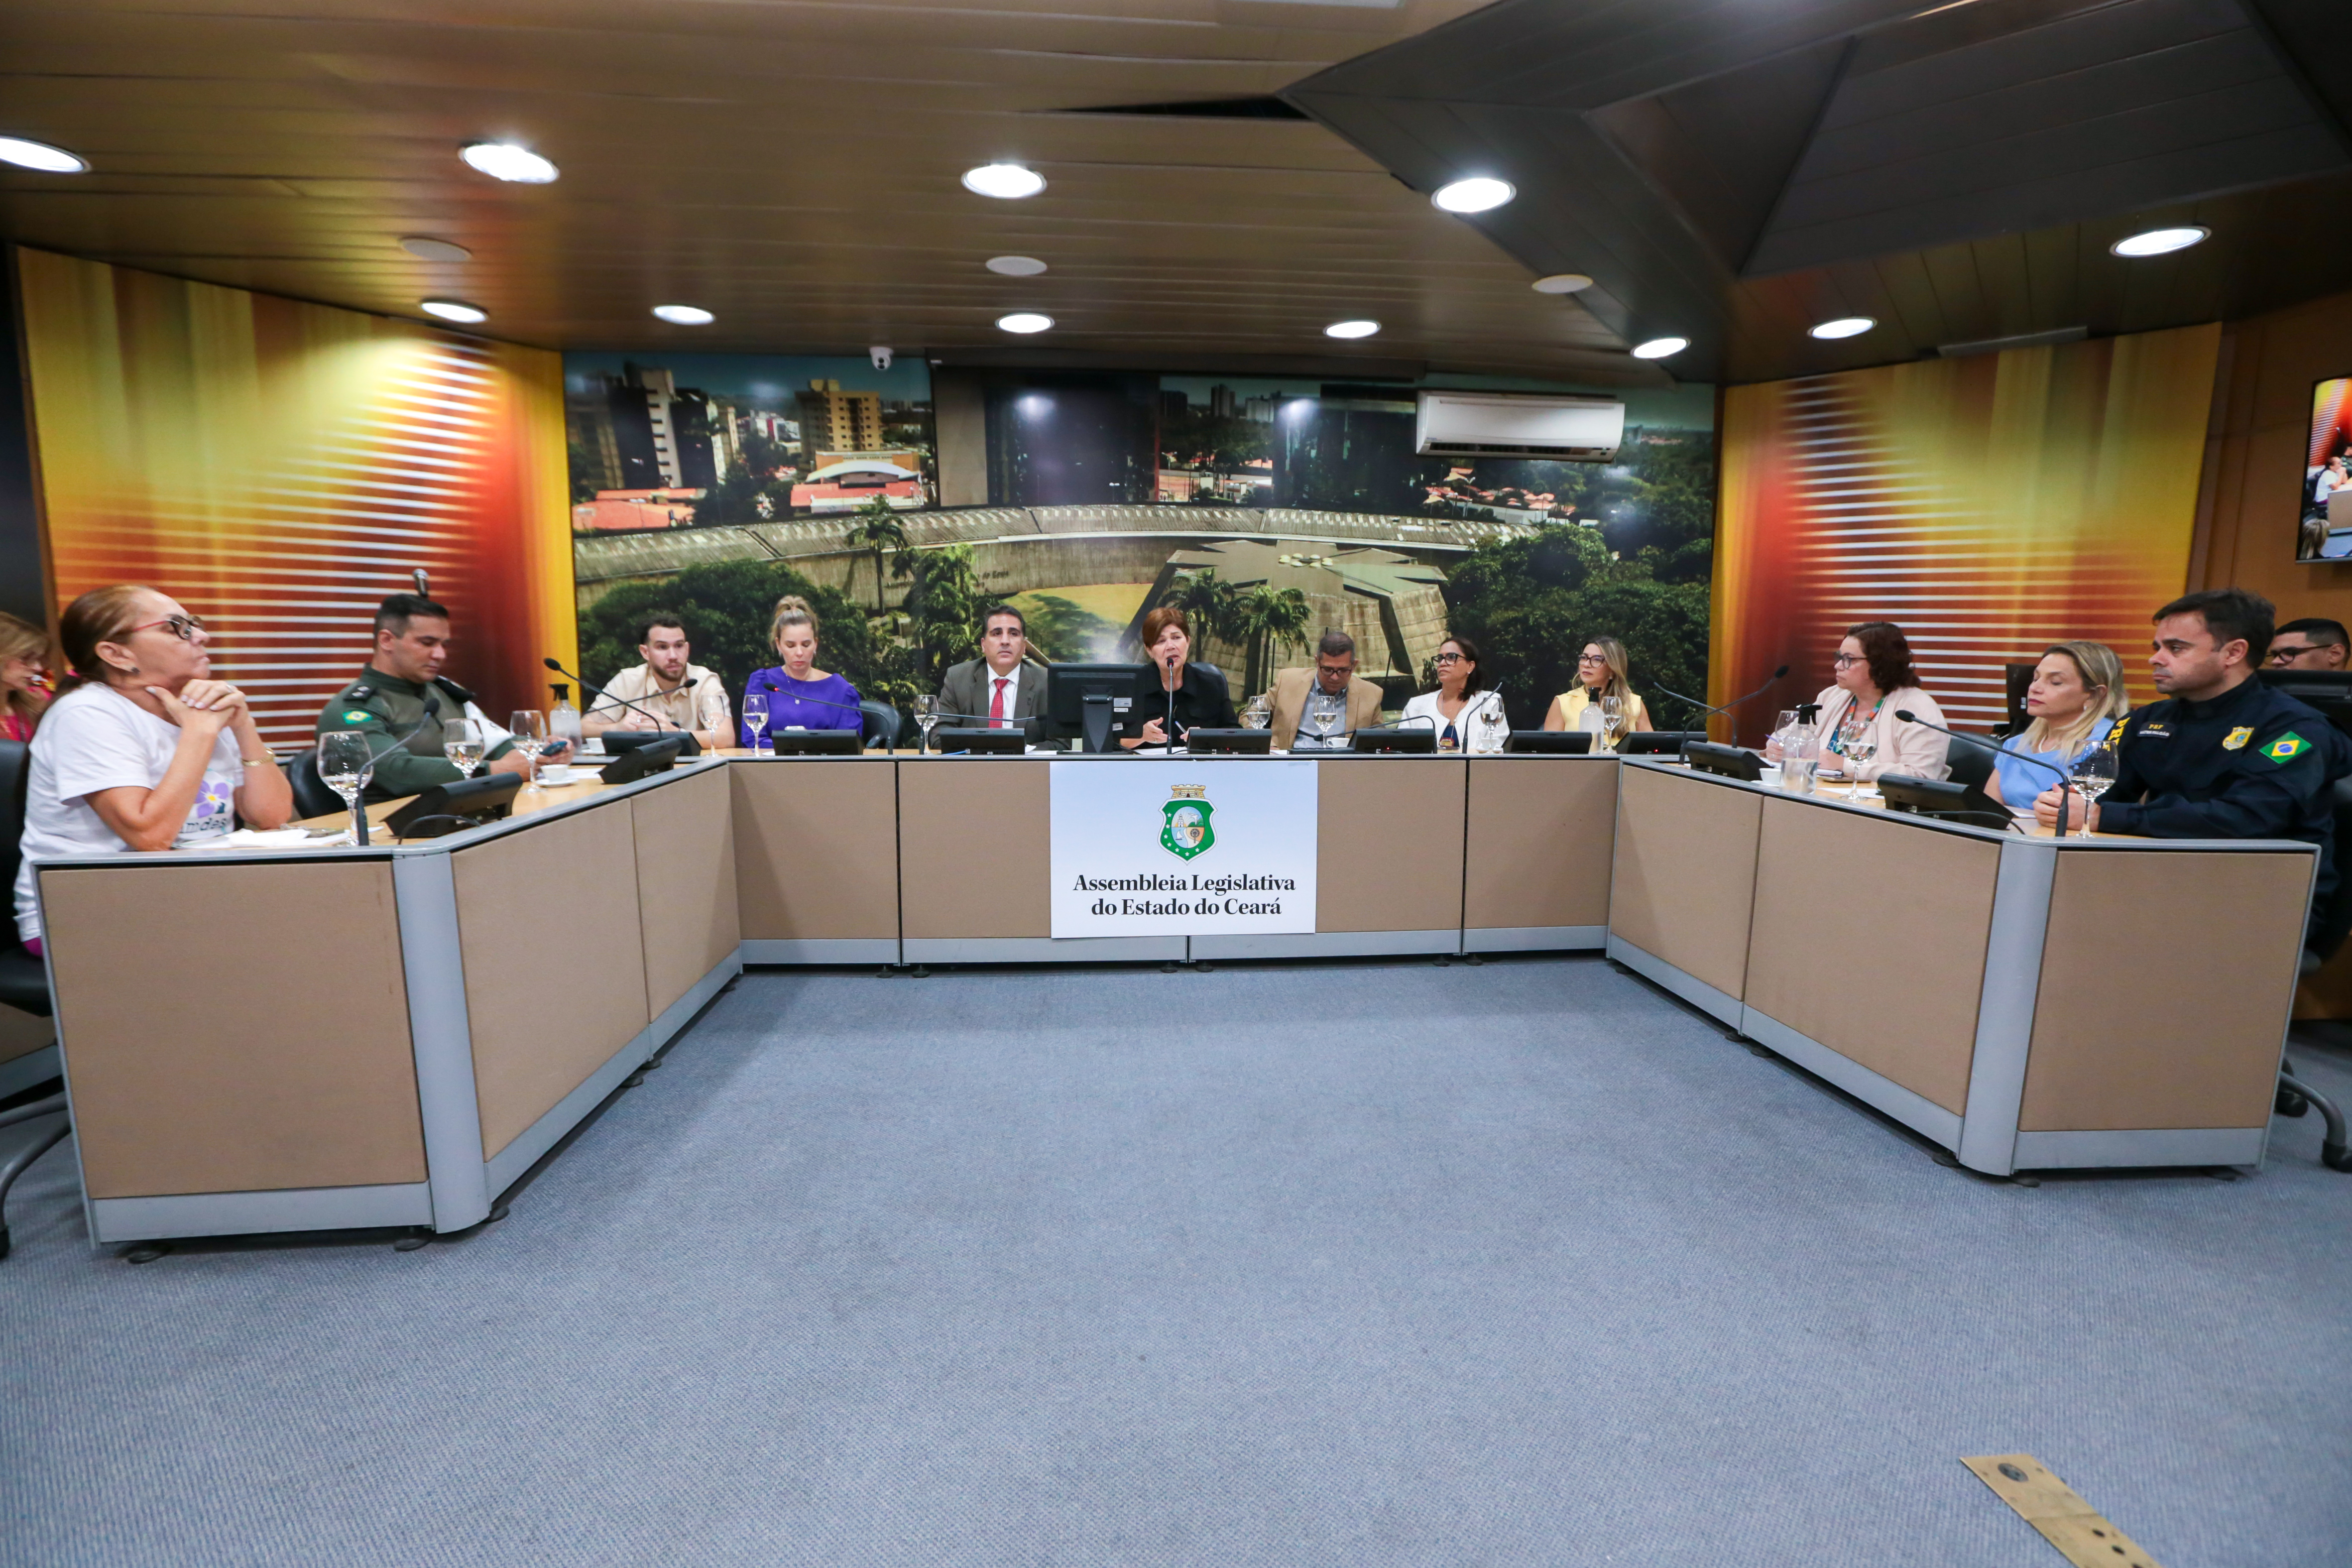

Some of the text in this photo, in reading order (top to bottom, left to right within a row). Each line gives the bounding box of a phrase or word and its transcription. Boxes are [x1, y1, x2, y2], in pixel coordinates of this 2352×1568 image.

[1073, 874, 1295, 896] Assembleia Legislativa
[1091, 897, 1282, 915] do Estado do Ceará
